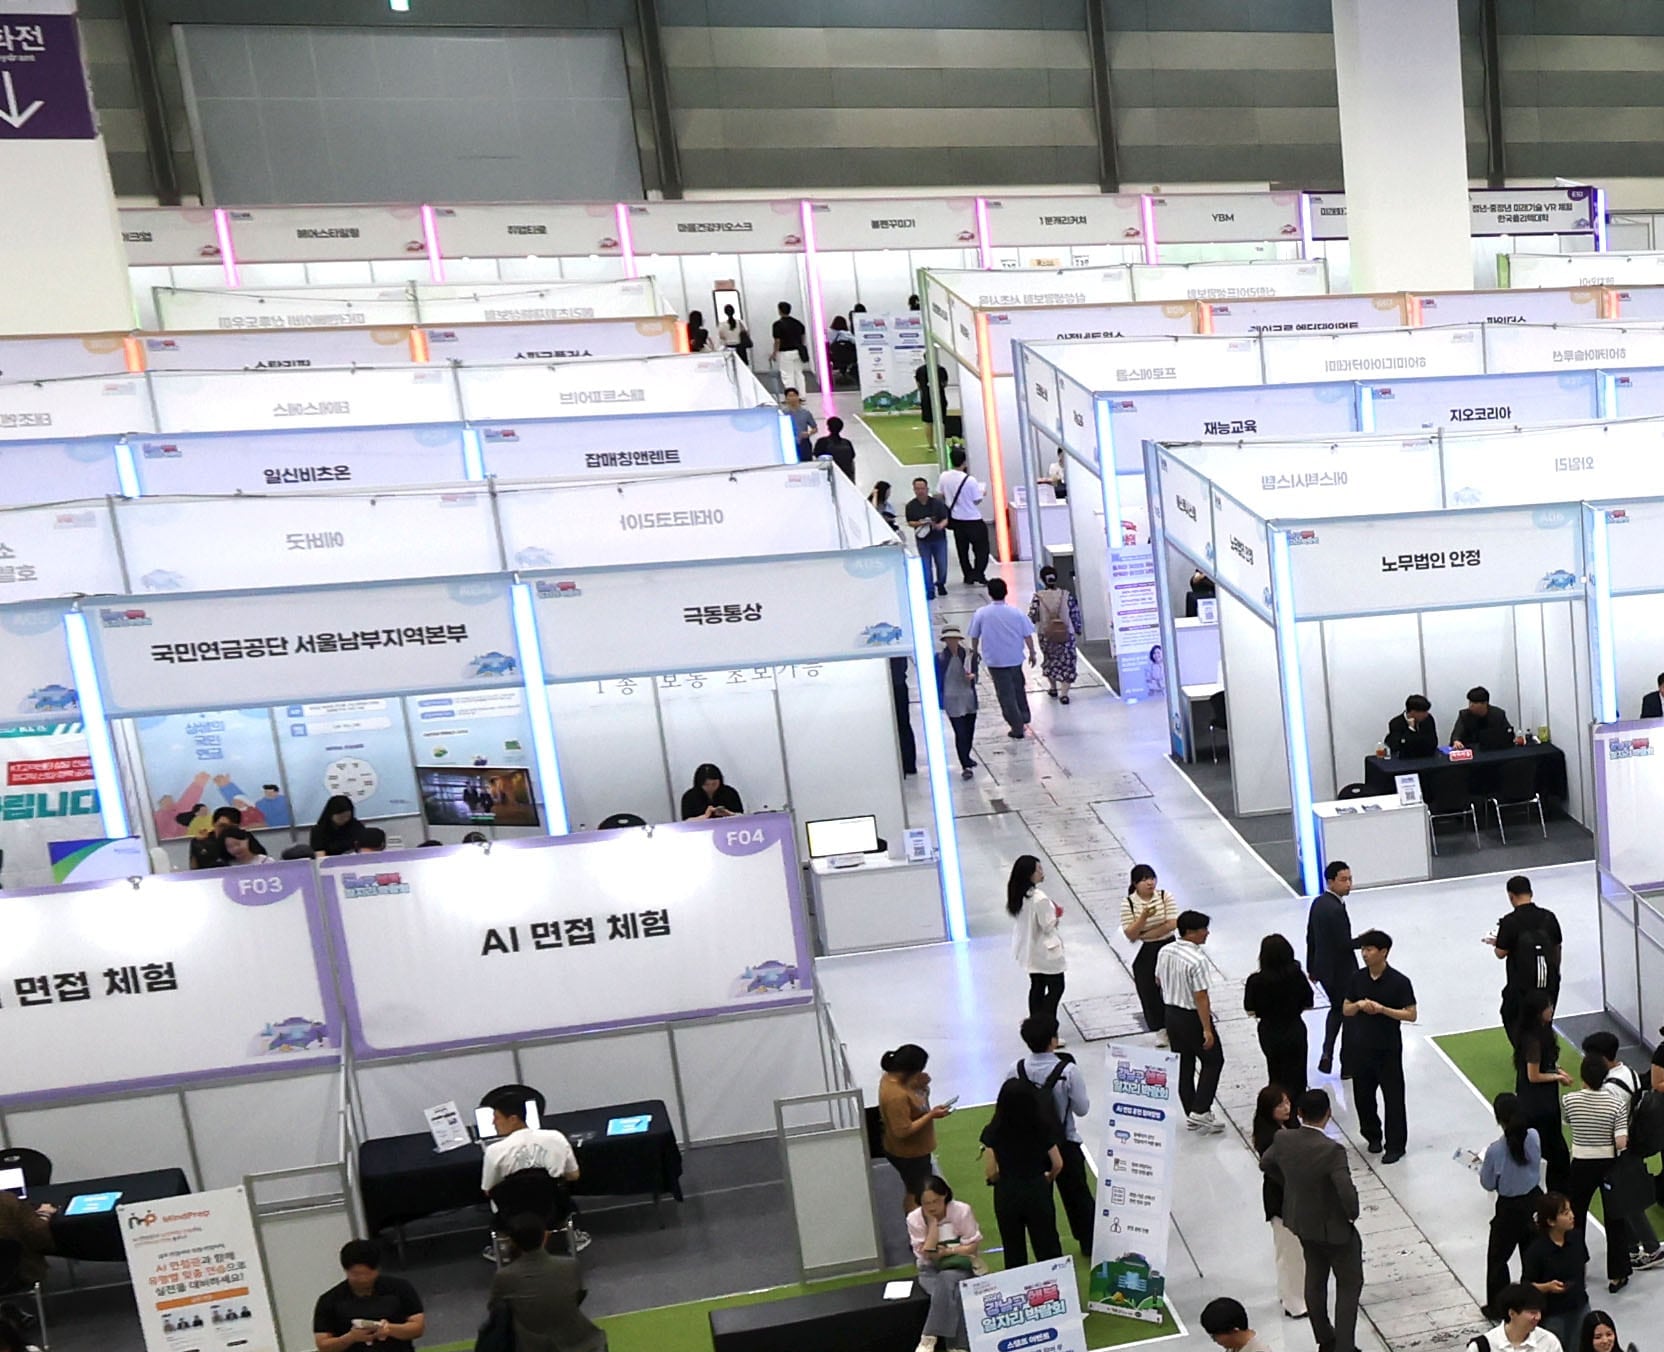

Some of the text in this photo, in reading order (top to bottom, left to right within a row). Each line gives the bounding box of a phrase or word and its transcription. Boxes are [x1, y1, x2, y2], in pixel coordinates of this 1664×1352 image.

[1211, 213, 1235, 223] YBM
[1450, 407, 1511, 421] 지오코리아
[1204, 419, 1257, 435] 재능교육
[263, 465, 352, 485] 일신비츠온
[1381, 550, 1481, 573] 노무법인 안정
[683, 603, 763, 626] 극동통상
[151, 624, 468, 664] 국민연금공단 서울남부지역본부
[726, 828, 765, 846] F04
[238, 877, 283, 895] F03
[480, 909, 671, 956] AI 면접 체험
[13, 962, 179, 1007] 면접 체험
[981, 1299, 1067, 1333] 일자리 박람회
